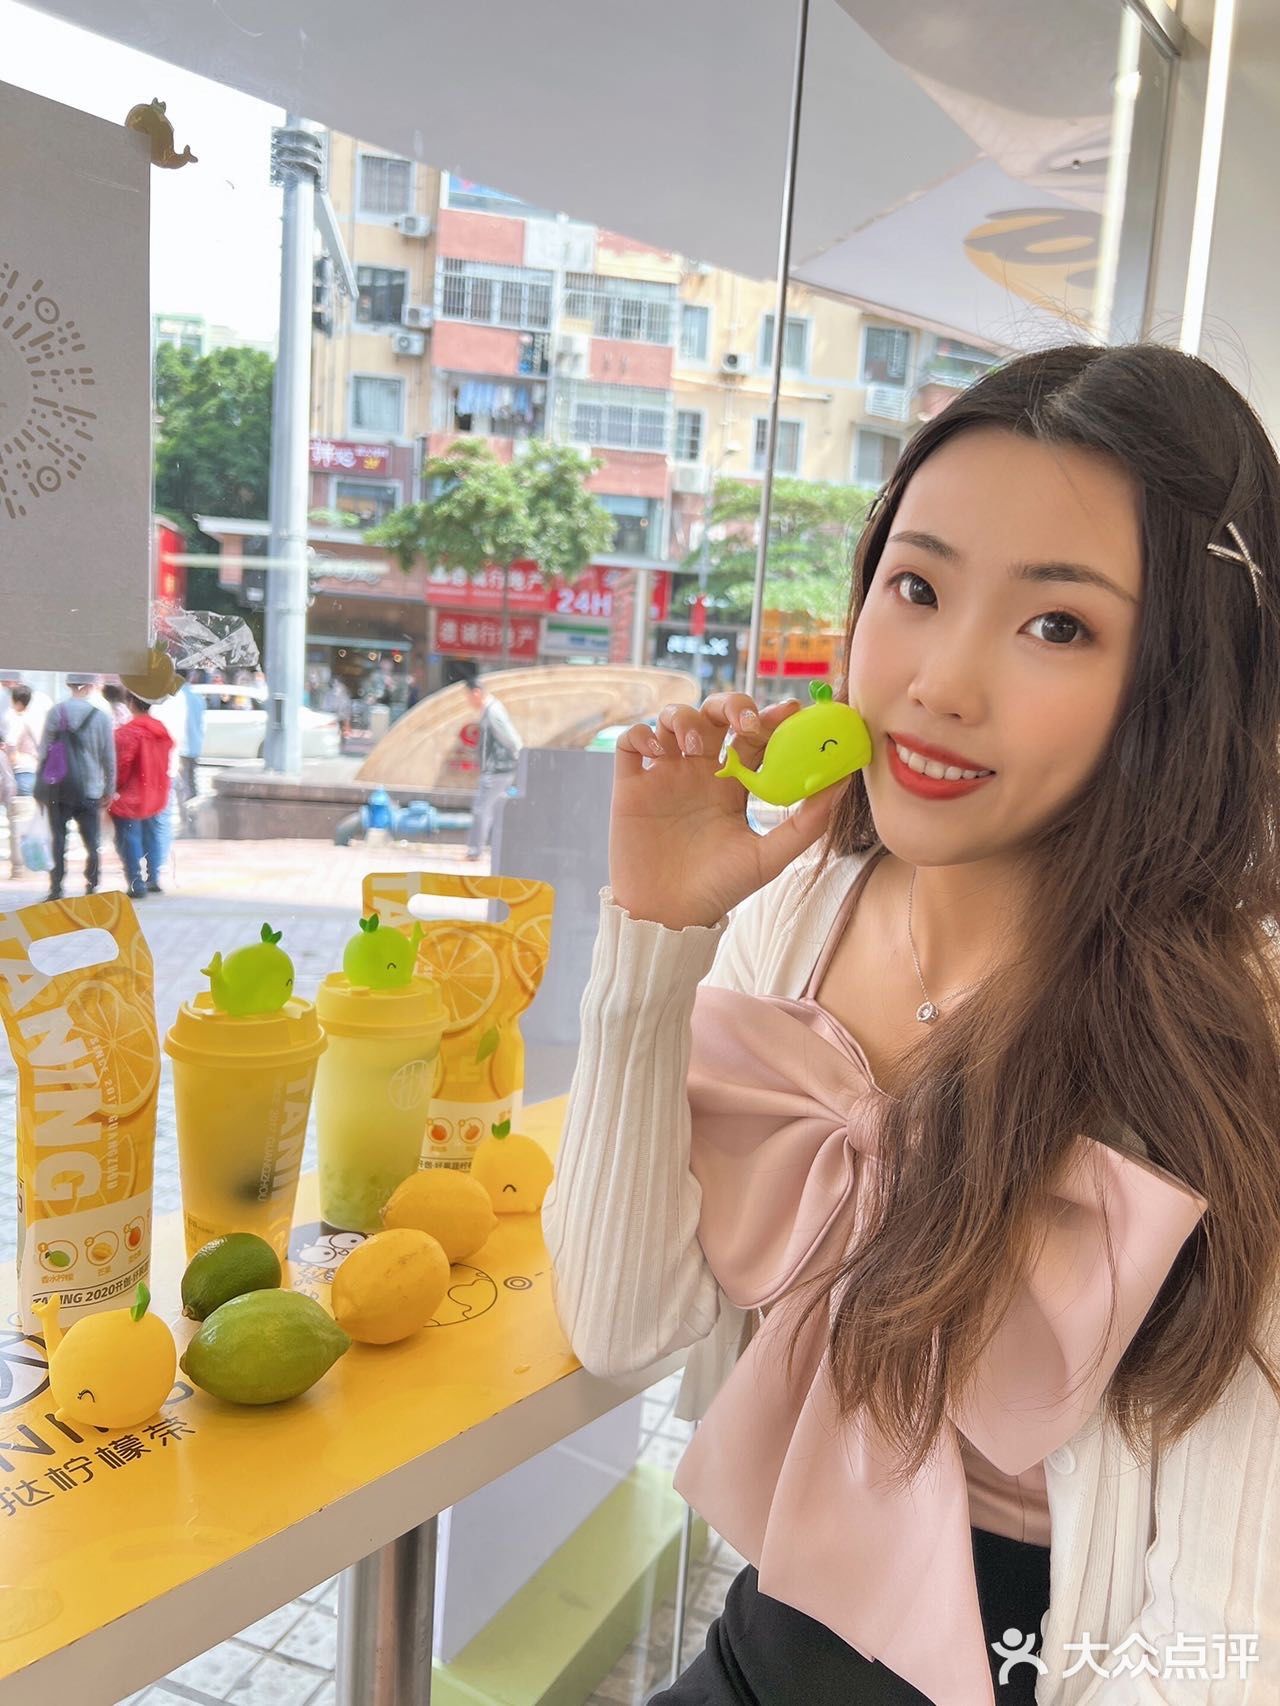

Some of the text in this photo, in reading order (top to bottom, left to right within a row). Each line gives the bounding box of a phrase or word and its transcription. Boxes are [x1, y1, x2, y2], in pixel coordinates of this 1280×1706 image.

[555, 588, 613, 617] 24H
[0, 910, 102, 1201] TANING
[106, 1115, 119, 1190] GUANGZHOU
[257, 1136, 275, 1202] GUANGZHOU
[32, 1292, 83, 1305] TAING
